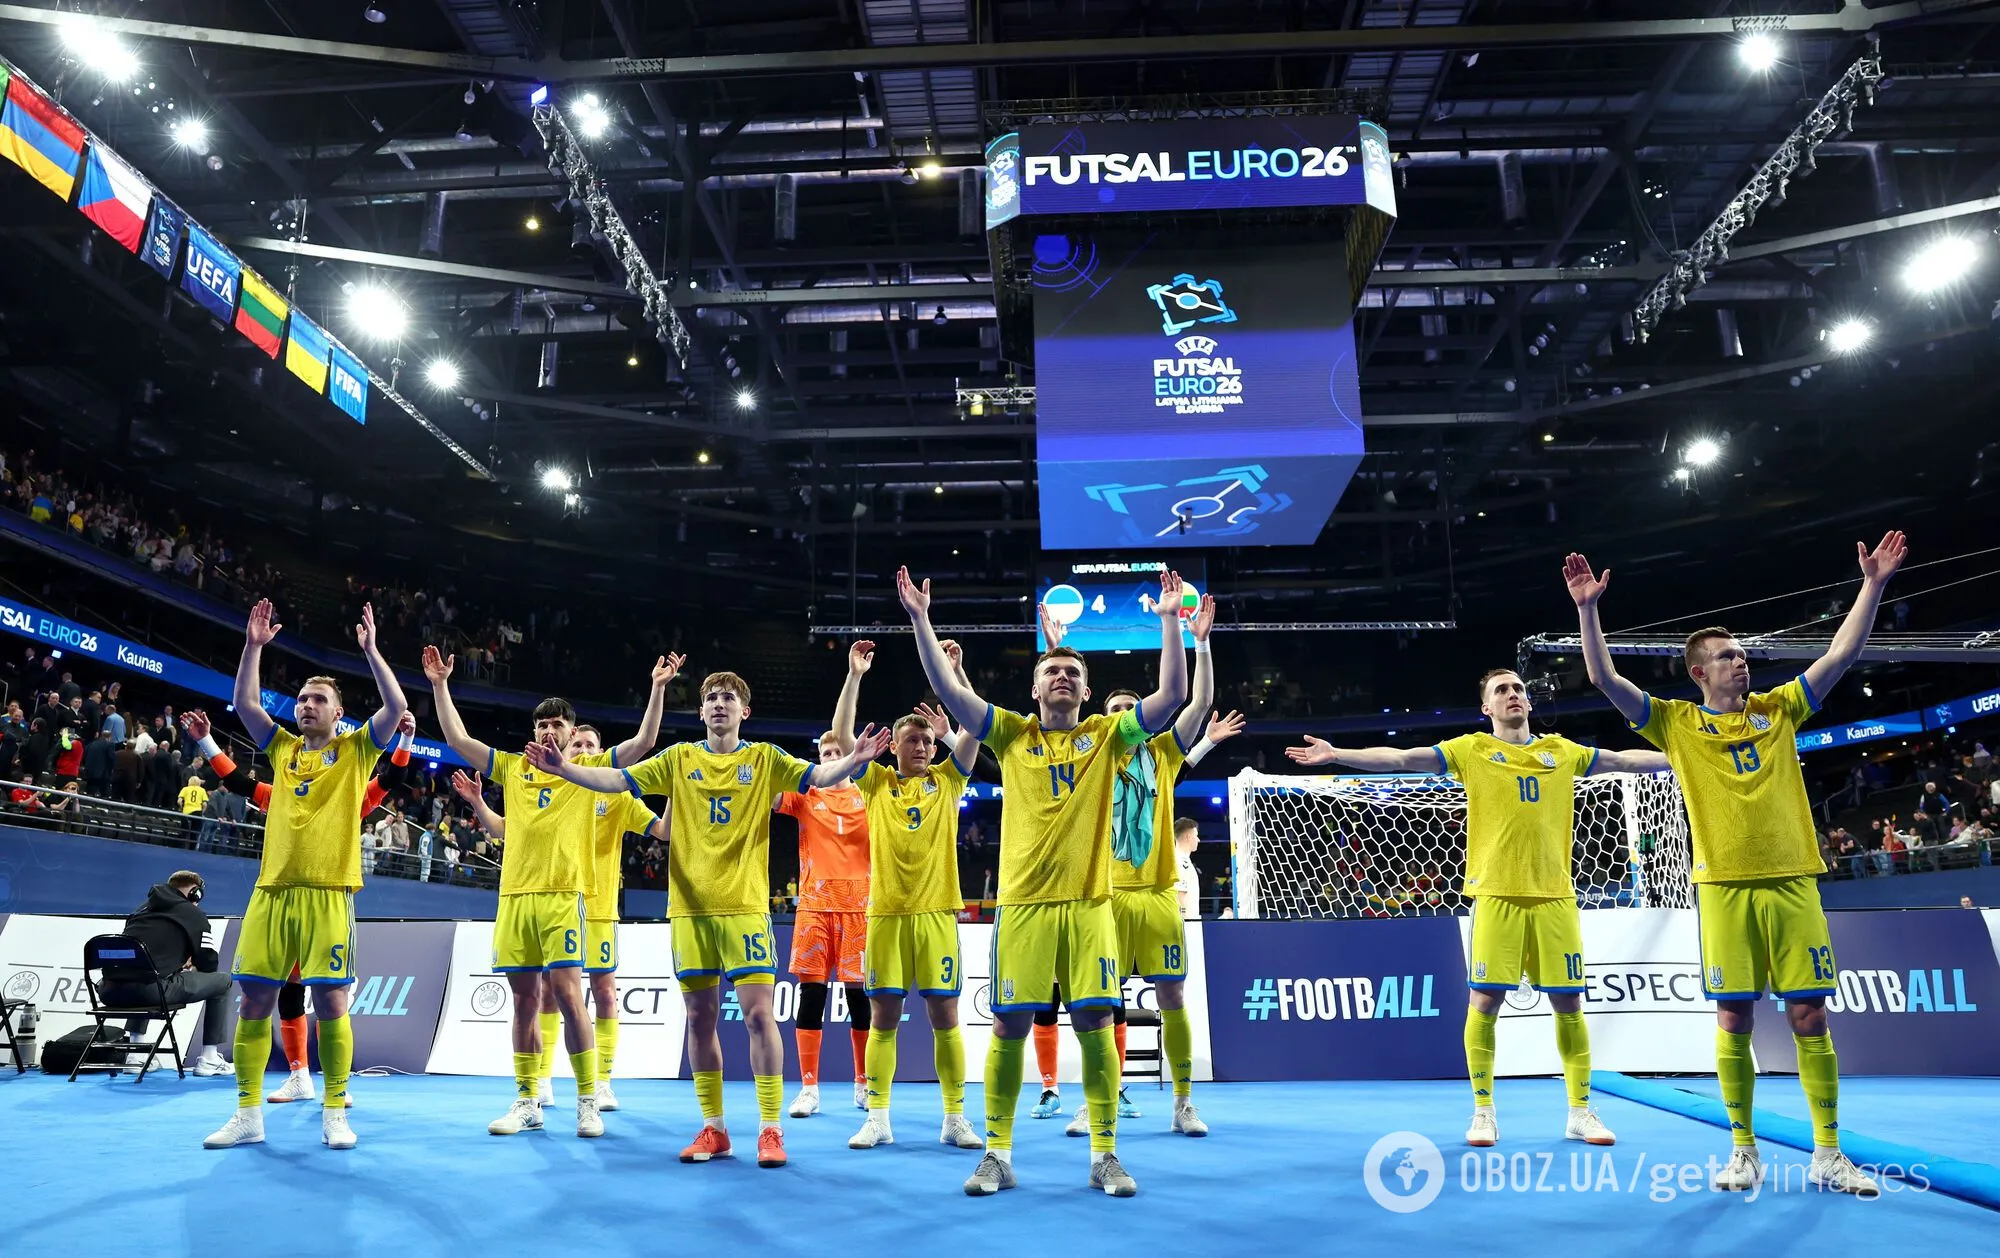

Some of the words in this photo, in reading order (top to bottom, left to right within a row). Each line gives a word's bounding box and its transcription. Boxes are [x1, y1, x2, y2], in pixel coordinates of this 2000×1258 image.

[187, 244, 233, 303] UEFA
[1174, 335, 1218, 356] UEFA
[1153, 357, 1242, 377] FUTSAL
[335, 365, 362, 404] FIFA
[1155, 376, 1243, 395] EURO26
[1091, 594, 1106, 614] 4
[1138, 593, 1150, 613] 1
[39, 619, 98, 652] EURO26
[117, 644, 163, 674] Kaunas
[1846, 724, 1885, 740] Kaunas
[411, 743, 442, 758] aunas
[1728, 741, 1761, 775] 13
[1048, 764, 1075, 797] 14
[1517, 775, 1540, 803] 10
[190, 790, 198, 803] 8
[538, 787, 552, 808] 6
[708, 796, 732, 824] 15
[836, 815, 843, 835] 1
[907, 806, 921, 829] 3
[564, 929, 577, 955] 6
[600, 942, 610, 963] 9
[742, 933, 767, 962] 15
[329, 944, 344, 972] 5
[941, 956, 954, 984] 3
[1163, 944, 1181, 970] 18
[1563, 952, 1582, 981] 10
[1808, 945, 1834, 980] 13
[15, 971, 36, 982] UEFA
[1099, 956, 1117, 991] 14
[480, 984, 501, 993] UEFA
[1242, 974, 1440, 1021] #FOOTBALL
[1585, 973, 1701, 1003] ESPEC
